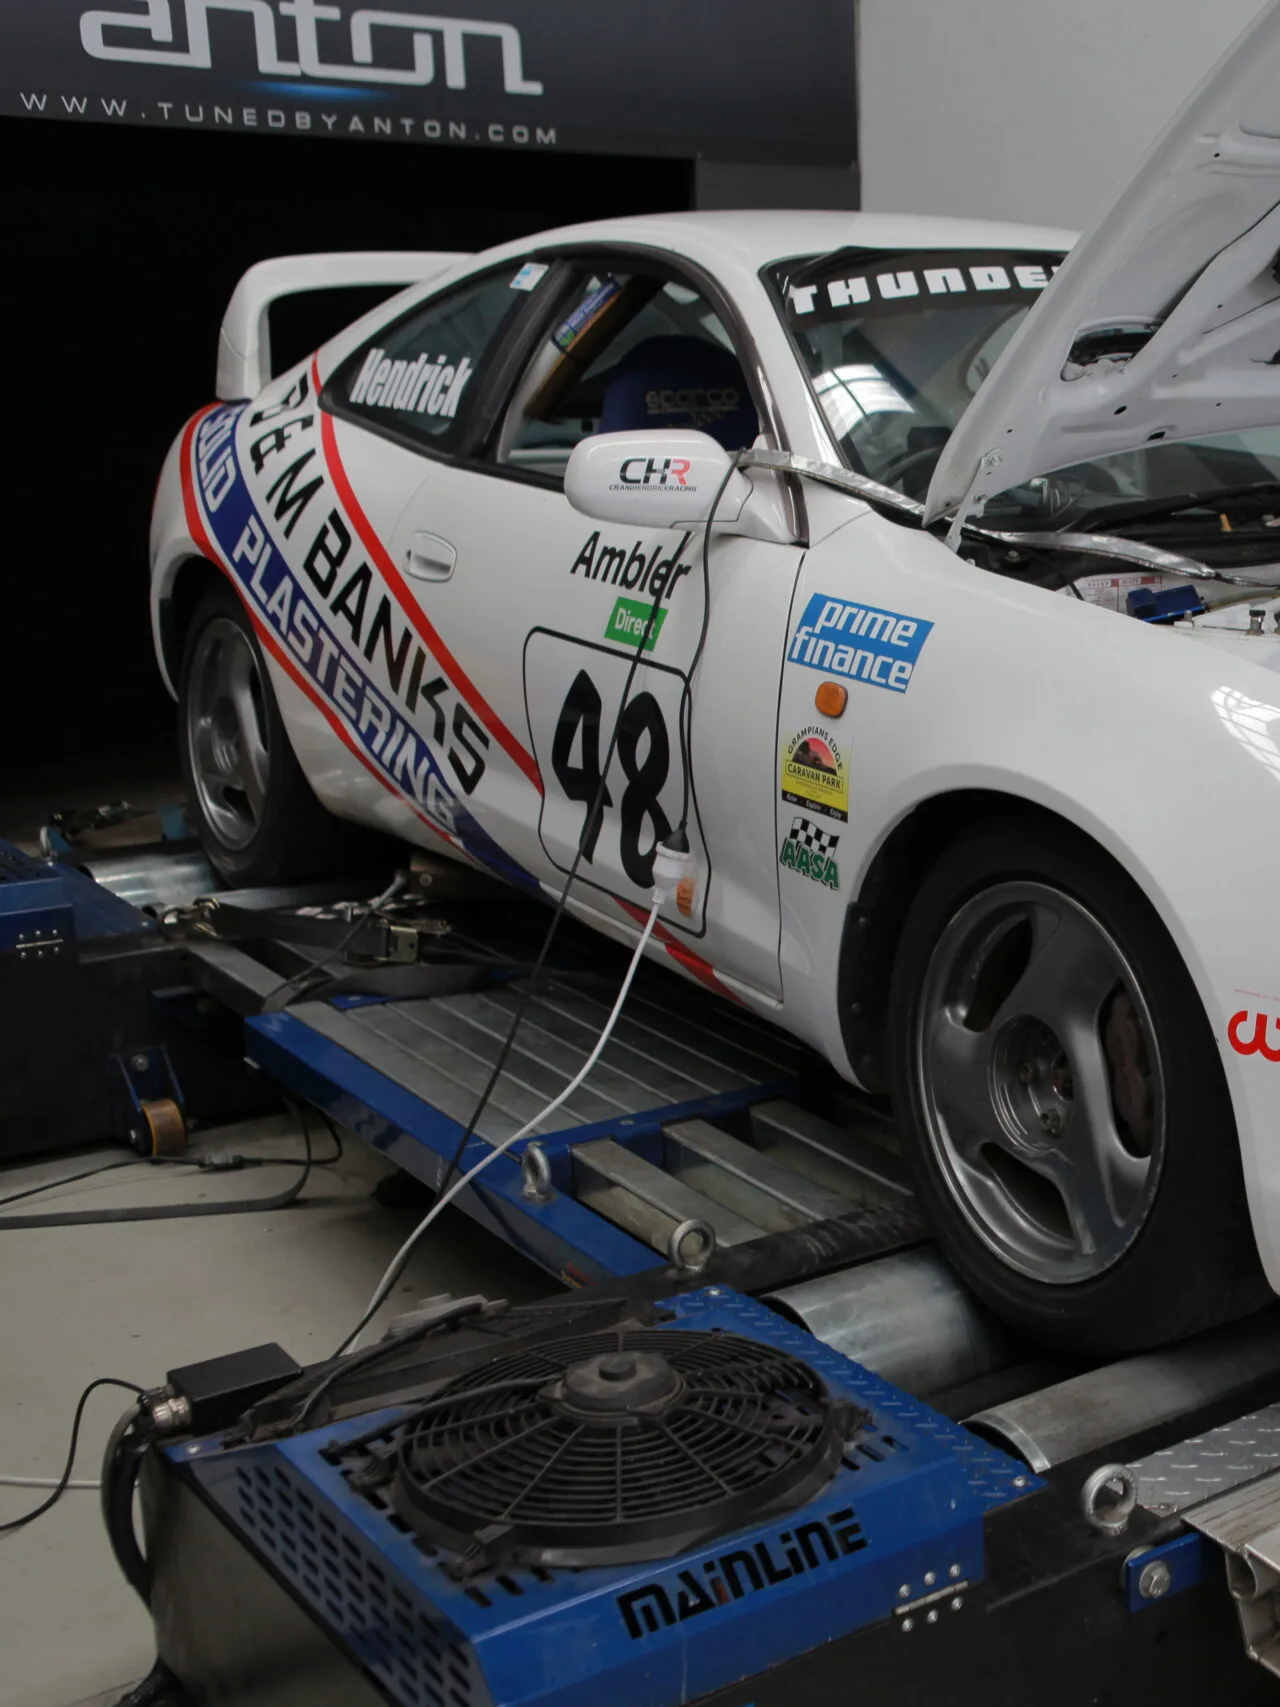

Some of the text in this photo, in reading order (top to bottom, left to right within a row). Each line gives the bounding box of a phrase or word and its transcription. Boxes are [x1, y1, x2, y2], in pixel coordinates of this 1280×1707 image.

[20, 91, 558, 146] WWW.TUNEDBYANTON.COM
[788, 264, 1060, 315] THUNDE
[349, 347, 473, 418] Hendrick
[619, 457, 691, 486] CHR
[569, 530, 693, 600] Ambler
[265, 447, 325, 540] M
[302, 507, 490, 796] BANKS
[813, 600, 918, 648] prime
[231, 514, 457, 835] PLASTERING
[791, 625, 914, 690] finance
[787, 726, 829, 754] GRAMPIANS
[551, 668, 670, 889] 48
[787, 763, 841, 789] CARAVAN PARK
[780, 837, 841, 891] AASA
